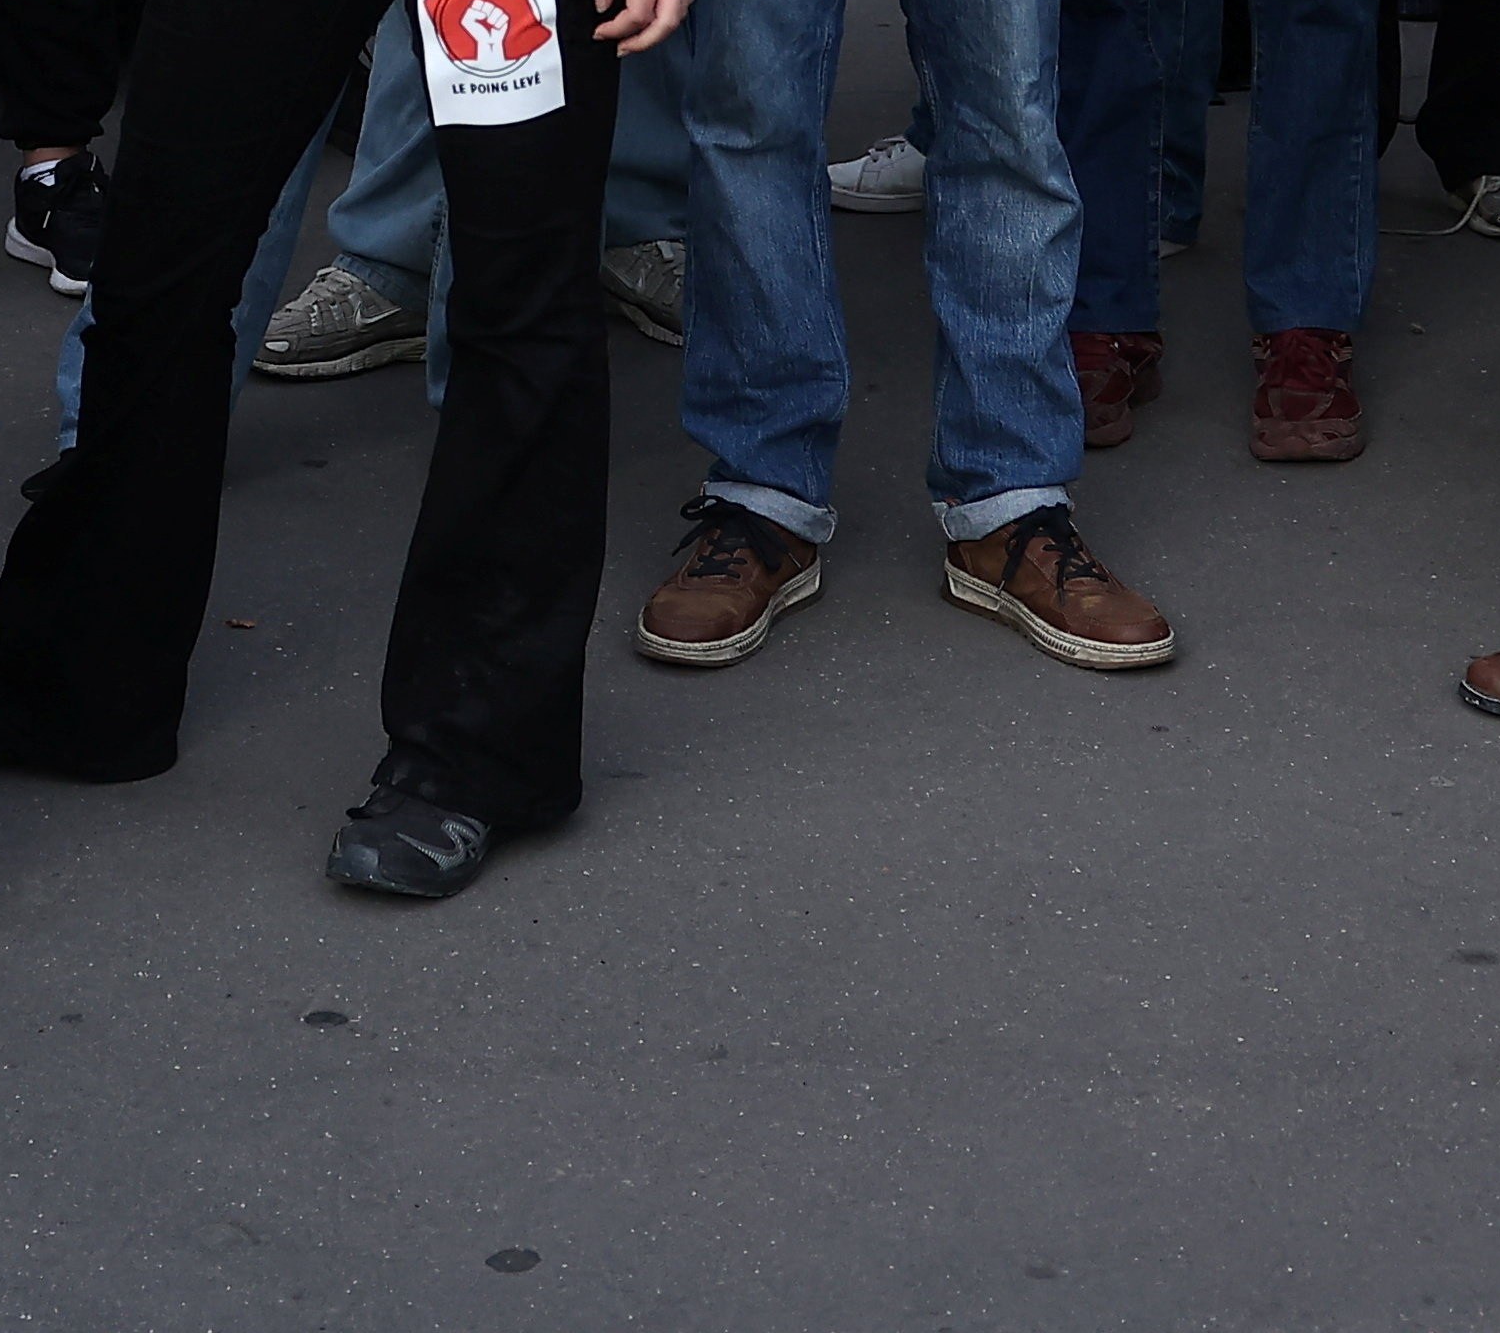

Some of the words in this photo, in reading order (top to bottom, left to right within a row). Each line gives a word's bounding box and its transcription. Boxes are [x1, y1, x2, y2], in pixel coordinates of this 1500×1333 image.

[452, 83, 467, 95] LE
[470, 80, 510, 95] POING
[513, 71, 542, 91] LEVÉ
